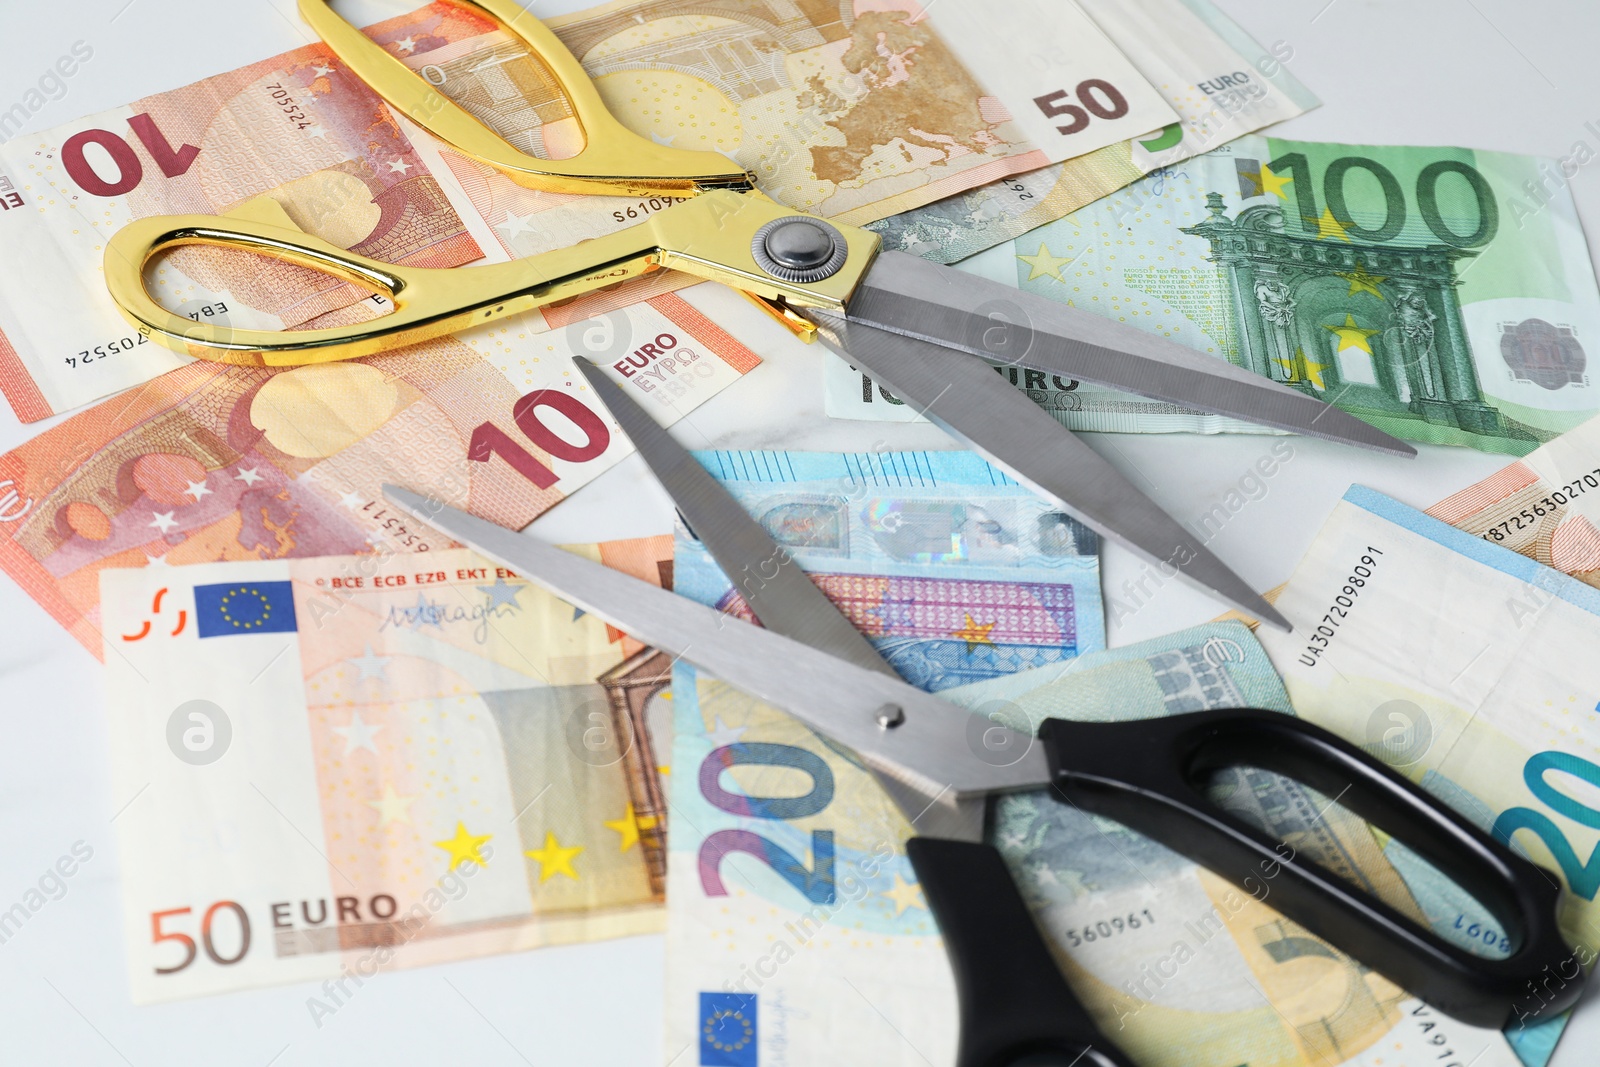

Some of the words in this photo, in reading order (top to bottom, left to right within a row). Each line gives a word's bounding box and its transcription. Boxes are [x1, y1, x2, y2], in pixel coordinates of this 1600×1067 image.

[266, 82, 311, 130] 705524
[1034, 78, 1130, 136] 50
[1197, 71, 1251, 95] EURO
[61, 113, 201, 197] 10
[1266, 151, 1500, 249] 100
[65, 332, 149, 369] 705524
[613, 333, 678, 378] EURO
[993, 367, 1080, 391] URO
[467, 389, 610, 490] 10
[363, 501, 429, 553] 654511
[1483, 468, 1600, 541] 87256302707
[332, 576, 363, 588] BCE
[374, 574, 407, 587] ECB
[415, 571, 447, 584] EZB
[456, 568, 487, 580] EKT
[495, 566, 523, 579] EK
[1299, 546, 1383, 667] UA3072098091
[697, 741, 835, 905] 20
[1492, 750, 1600, 902] 20
[150, 899, 252, 975] 50
[270, 894, 398, 929] EURO
[1066, 909, 1155, 948] 560961
